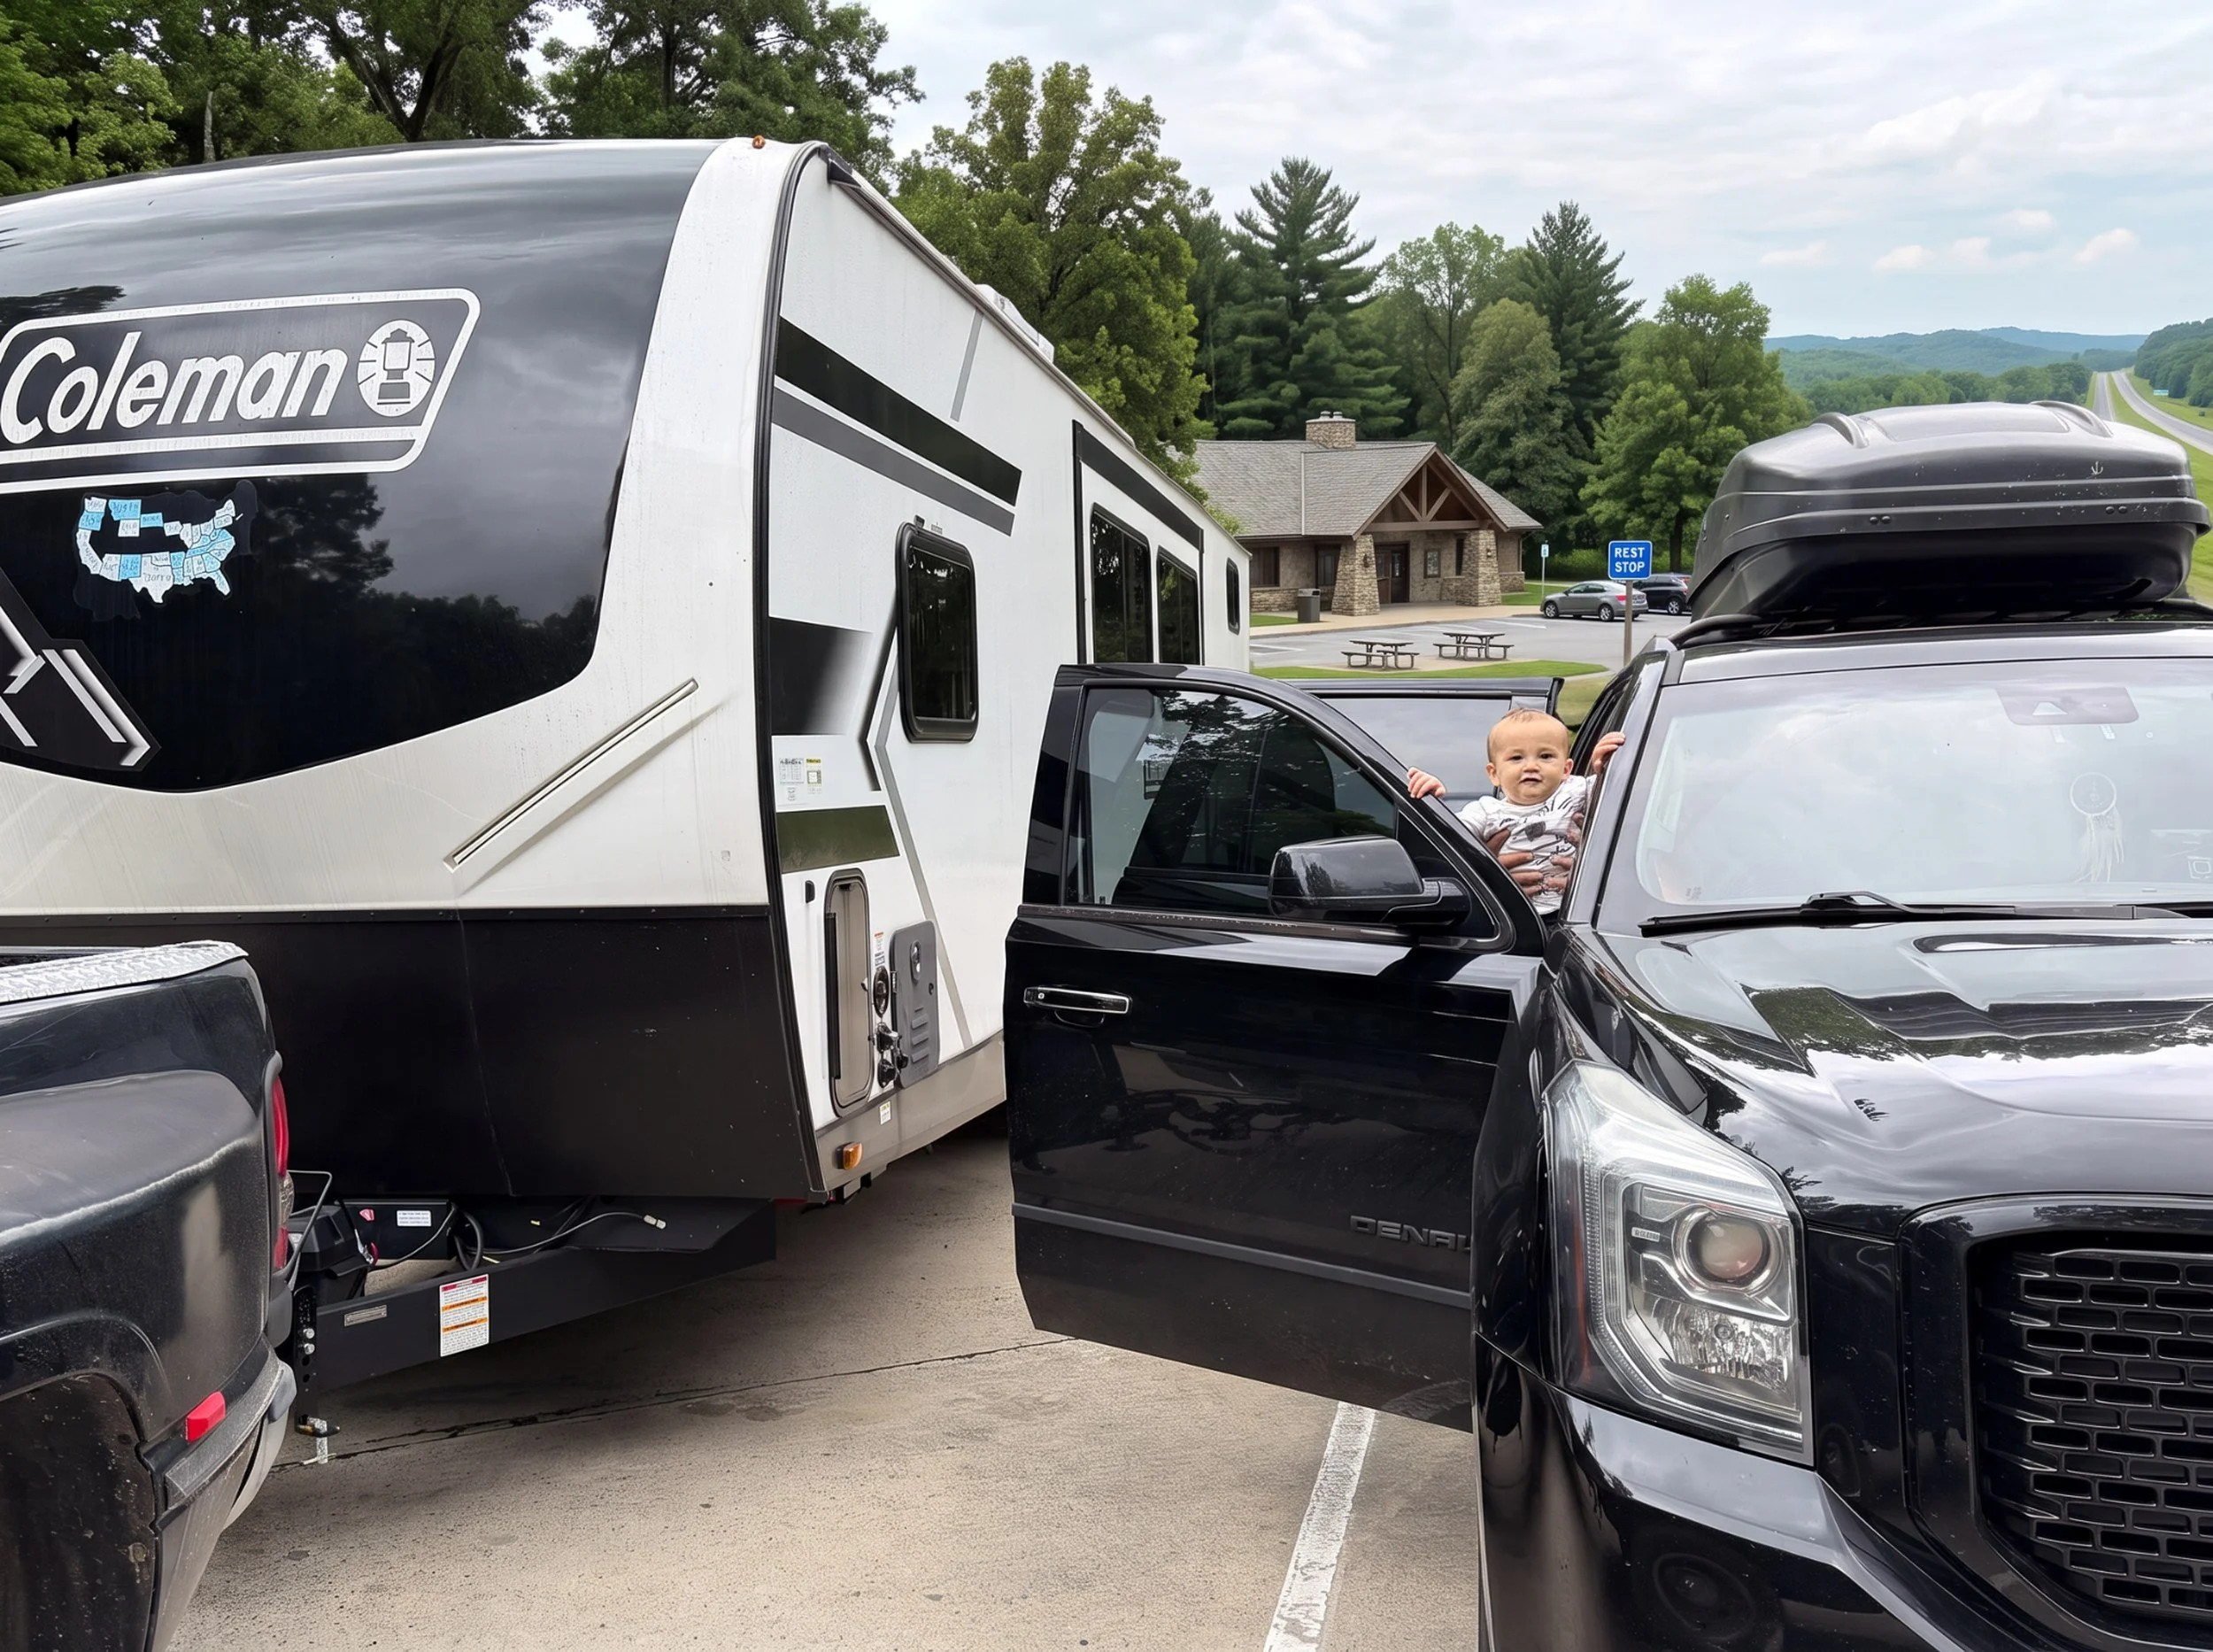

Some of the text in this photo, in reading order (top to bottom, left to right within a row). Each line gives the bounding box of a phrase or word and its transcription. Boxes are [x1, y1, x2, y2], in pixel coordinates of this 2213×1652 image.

[1, 331, 349, 444] Coleman
[1614, 547, 1645, 559] REST
[1615, 561, 1646, 573] STOP
[1350, 1215, 1471, 1254] DENAL
